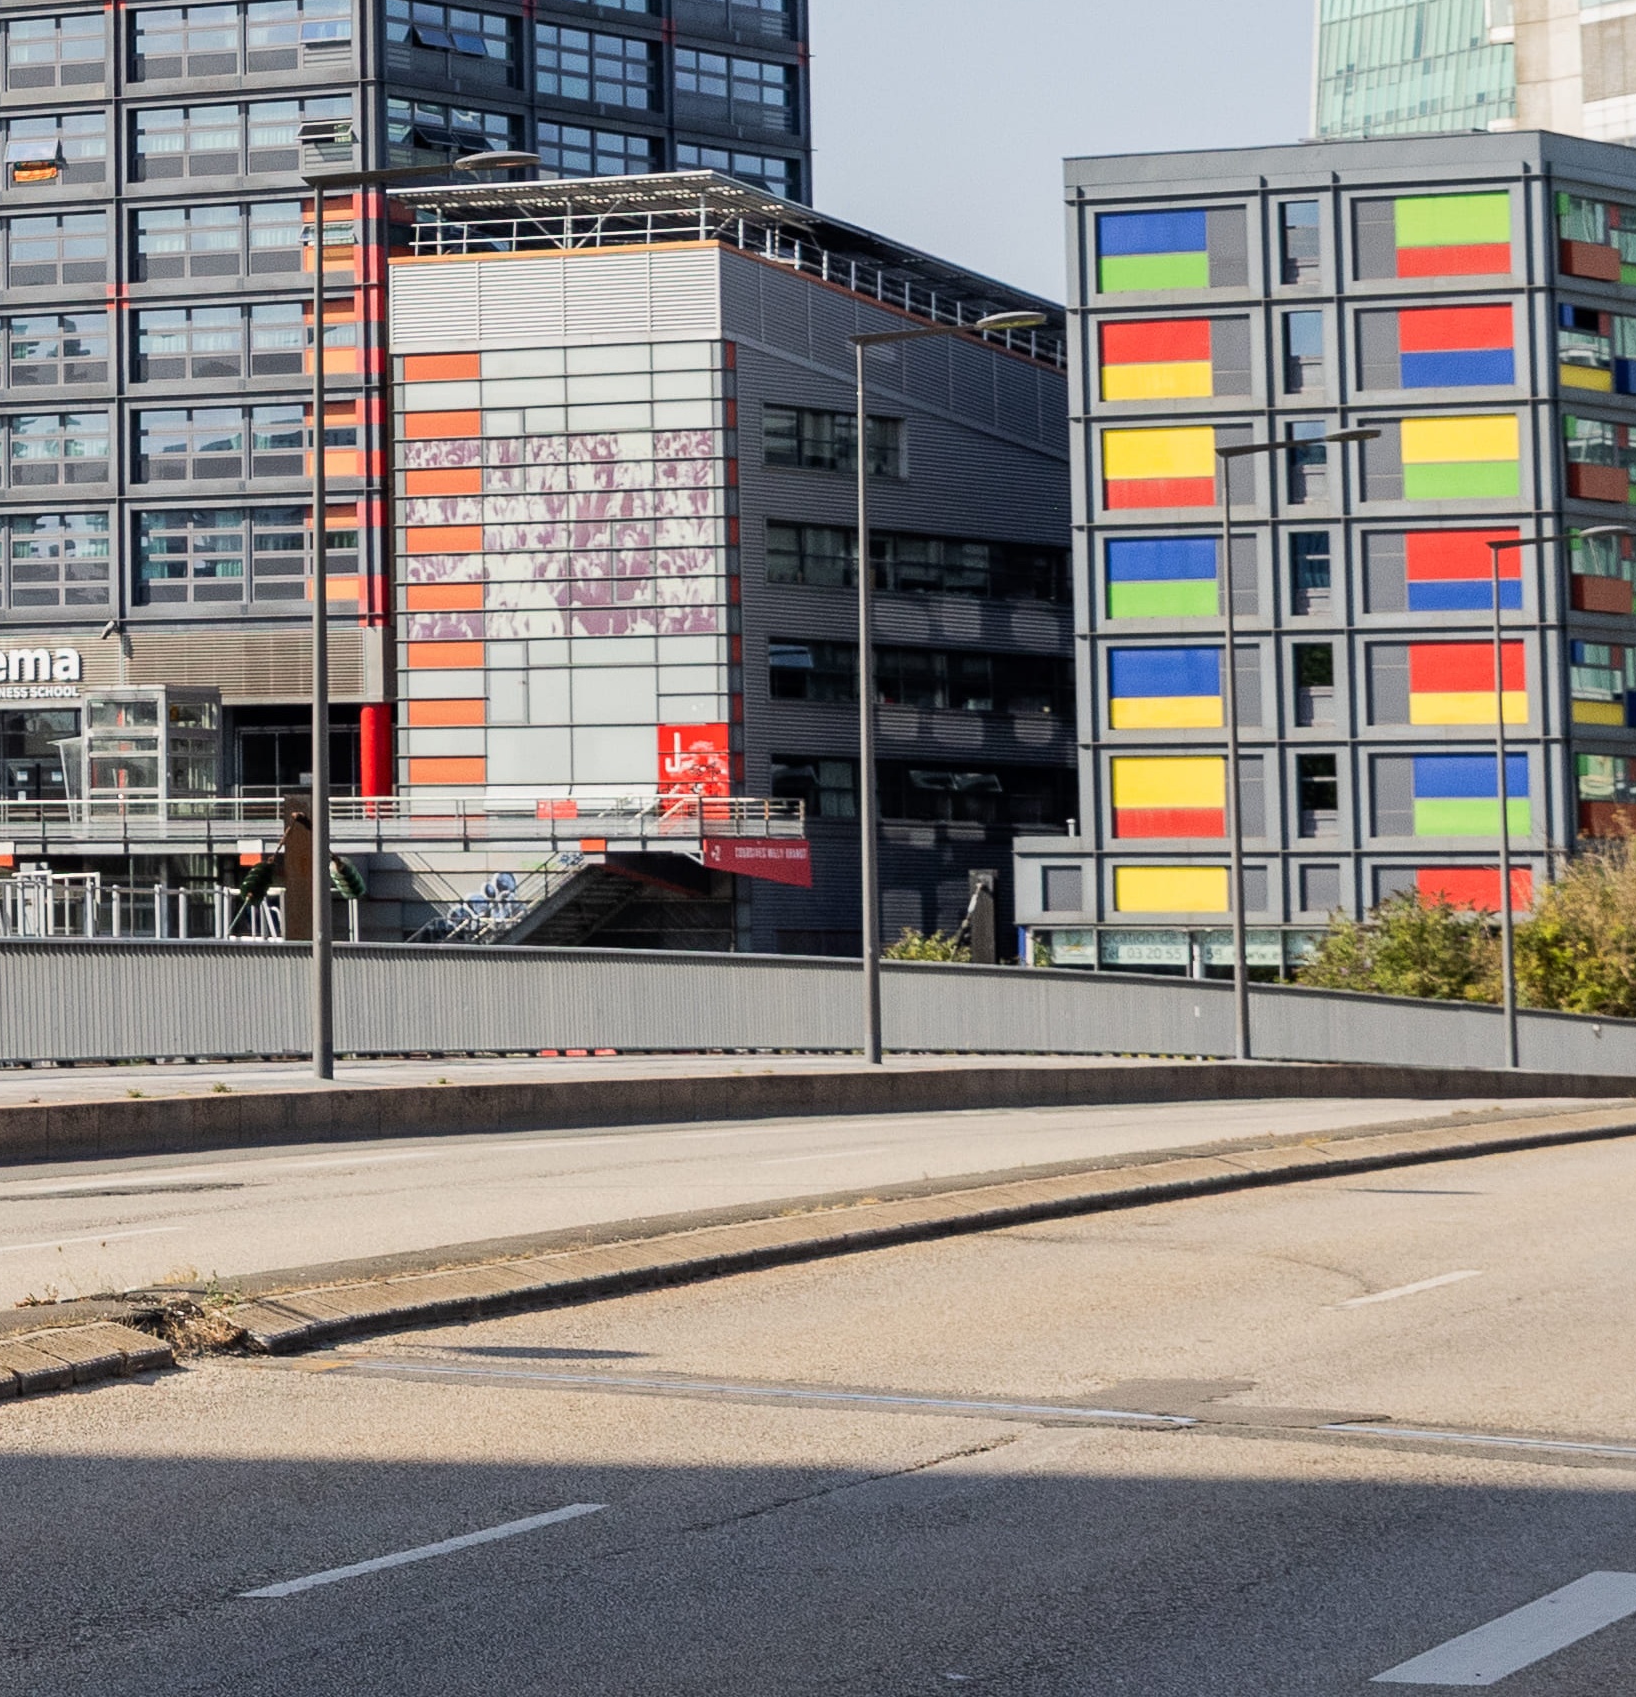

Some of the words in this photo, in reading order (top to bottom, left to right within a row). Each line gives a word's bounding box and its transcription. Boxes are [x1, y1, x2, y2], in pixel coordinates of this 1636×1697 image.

[30, 686, 80, 698] SCHOOL
[1127, 947, 1143, 960] 03
[1146, 947, 1162, 960] 20
[1165, 947, 1182, 960] 55
